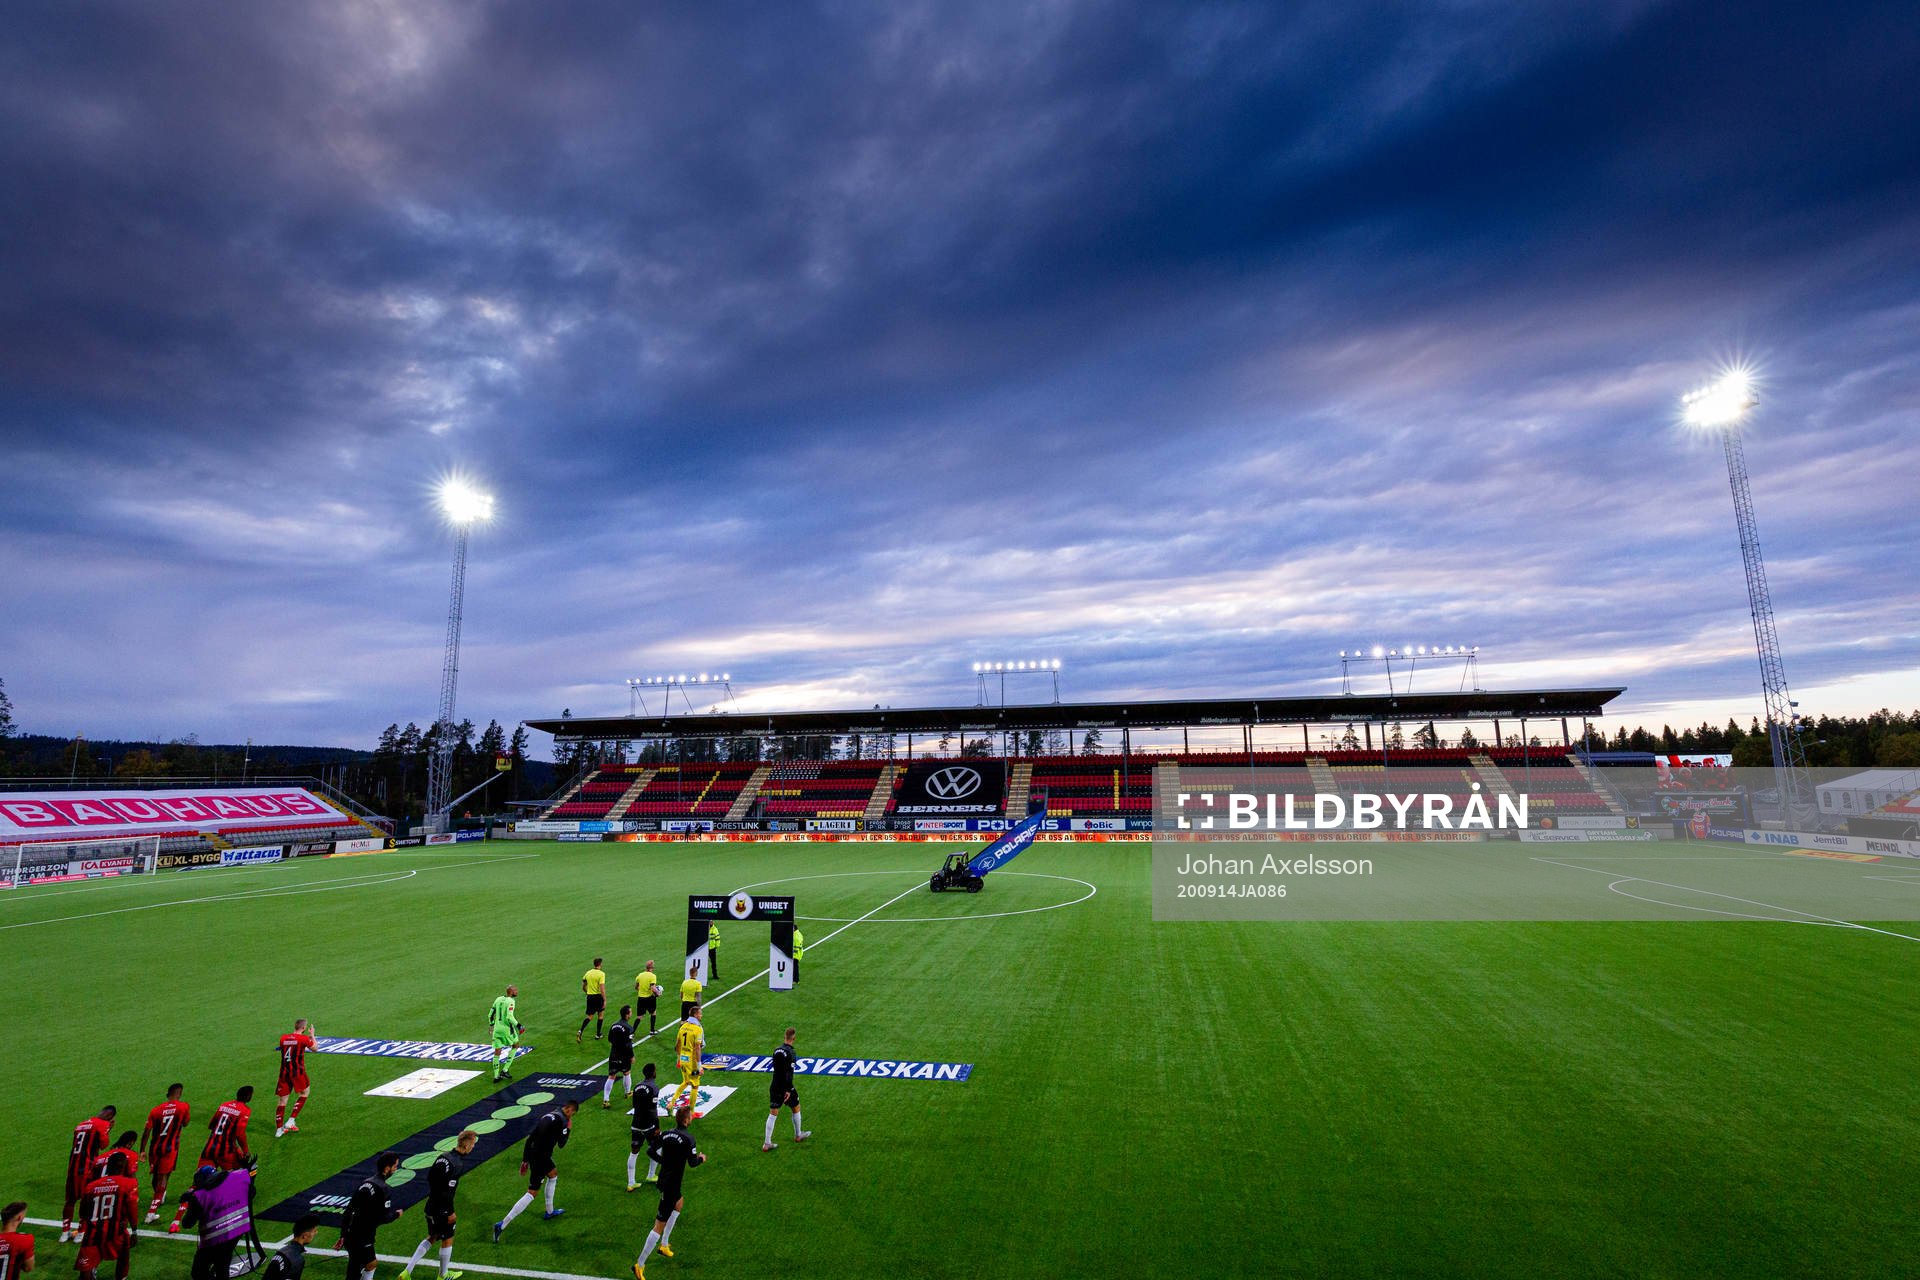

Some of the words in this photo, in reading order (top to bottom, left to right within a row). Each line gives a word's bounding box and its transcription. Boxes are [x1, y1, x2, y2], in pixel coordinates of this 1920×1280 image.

[2, 796, 316, 823] BAUHAUS
[897, 804, 997, 814] BERNERS
[713, 822, 760, 830] FORESTLINK
[820, 821, 846, 829] LAGER
[923, 821, 965, 829] INTERSPORT
[977, 820, 1059, 831] POLIS
[1130, 820, 1156, 828] winpos
[456, 831, 485, 839] POLARIS
[1711, 829, 1744, 839] POLARIS
[1765, 833, 1799, 845] INAB
[994, 823, 1039, 860] POLARIS
[1813, 836, 1848, 846] JemtBil
[1866, 840, 1902, 854] MEINDL
[174, 853, 221, 865] XL-BYGG
[1, 864, 68, 875] THORGERZON
[81, 861, 99, 871] ICA
[694, 901, 724, 909] UNIBET
[758, 901, 789, 910] UNIBET
[777, 961, 786, 972] U
[683, 1032, 688, 1046] 1
[284, 1046, 291, 1062] 4
[732, 1056, 961, 1080] ALSVENSKAN
[536, 1077, 597, 1087] UNIBET
[160, 1115, 174, 1136] 7
[73, 1131, 86, 1154] 3
[309, 1194, 352, 1207] UNI
[90, 1194, 116, 1222] 18
